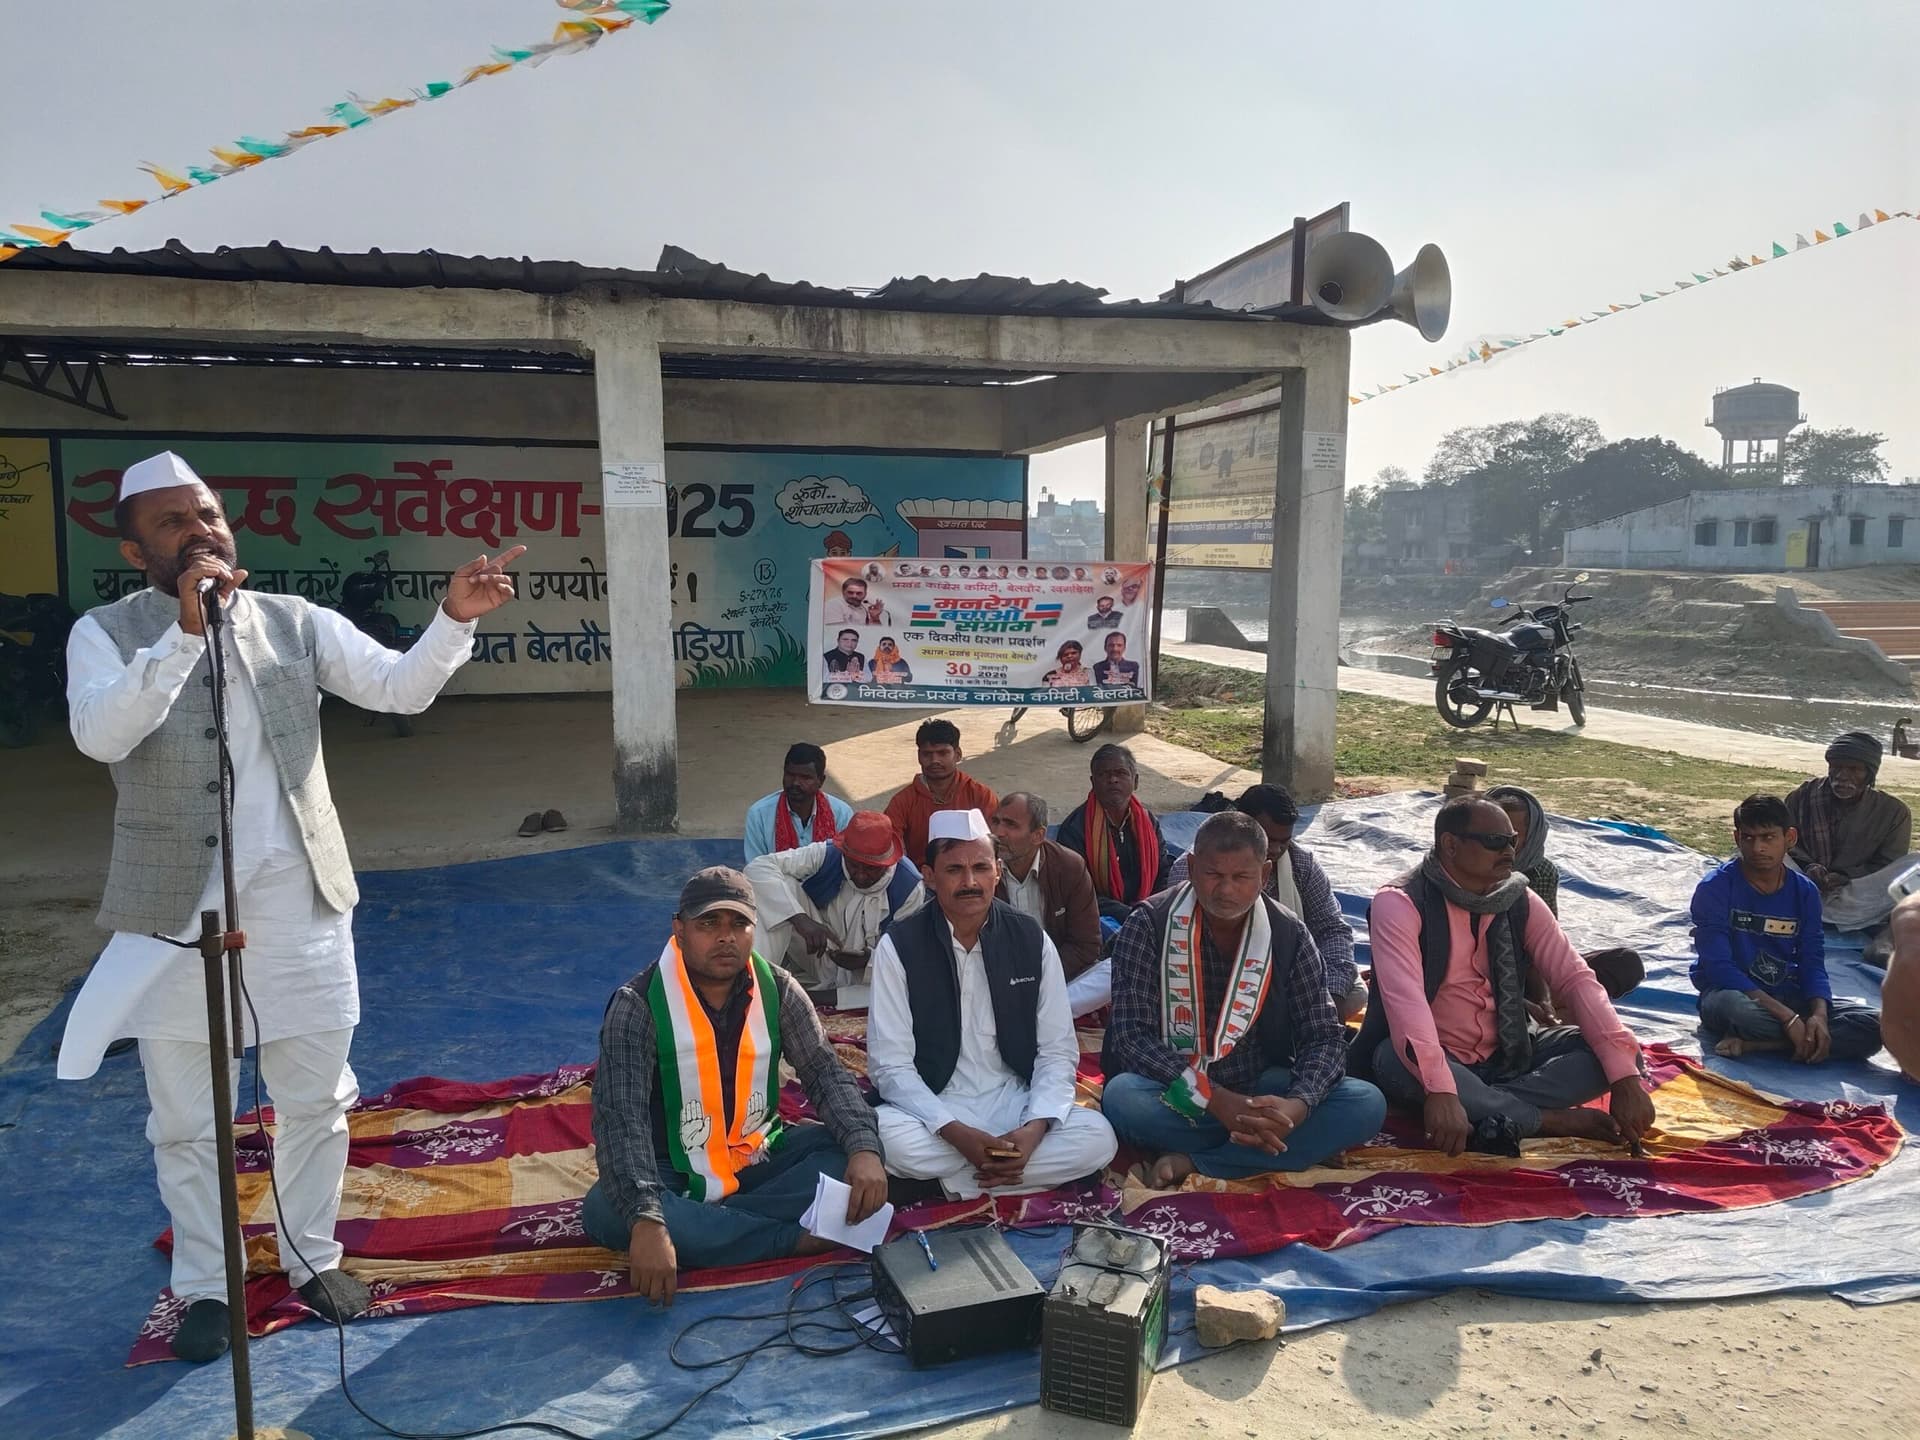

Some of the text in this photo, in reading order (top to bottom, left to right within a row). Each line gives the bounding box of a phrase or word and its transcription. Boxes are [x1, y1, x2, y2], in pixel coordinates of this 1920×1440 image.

[529, 557, 608, 602] उपयो
[760, 564, 771, 581] 13
[934, 595, 1033, 610] मनरेगा
[940, 606, 1024, 622] बचाओ
[954, 618, 1037, 633] संग्राम
[903, 631, 1046, 648] एक दिवसीय धरना प्रदर्शन
[946, 662, 972, 676] 30
[978, 671, 1008, 679] 2026
[974, 688, 1025, 702] कांग्रेस
[1030, 687, 1086, 702] कमिटी,
[1093, 685, 1144, 699] बेलदौर
